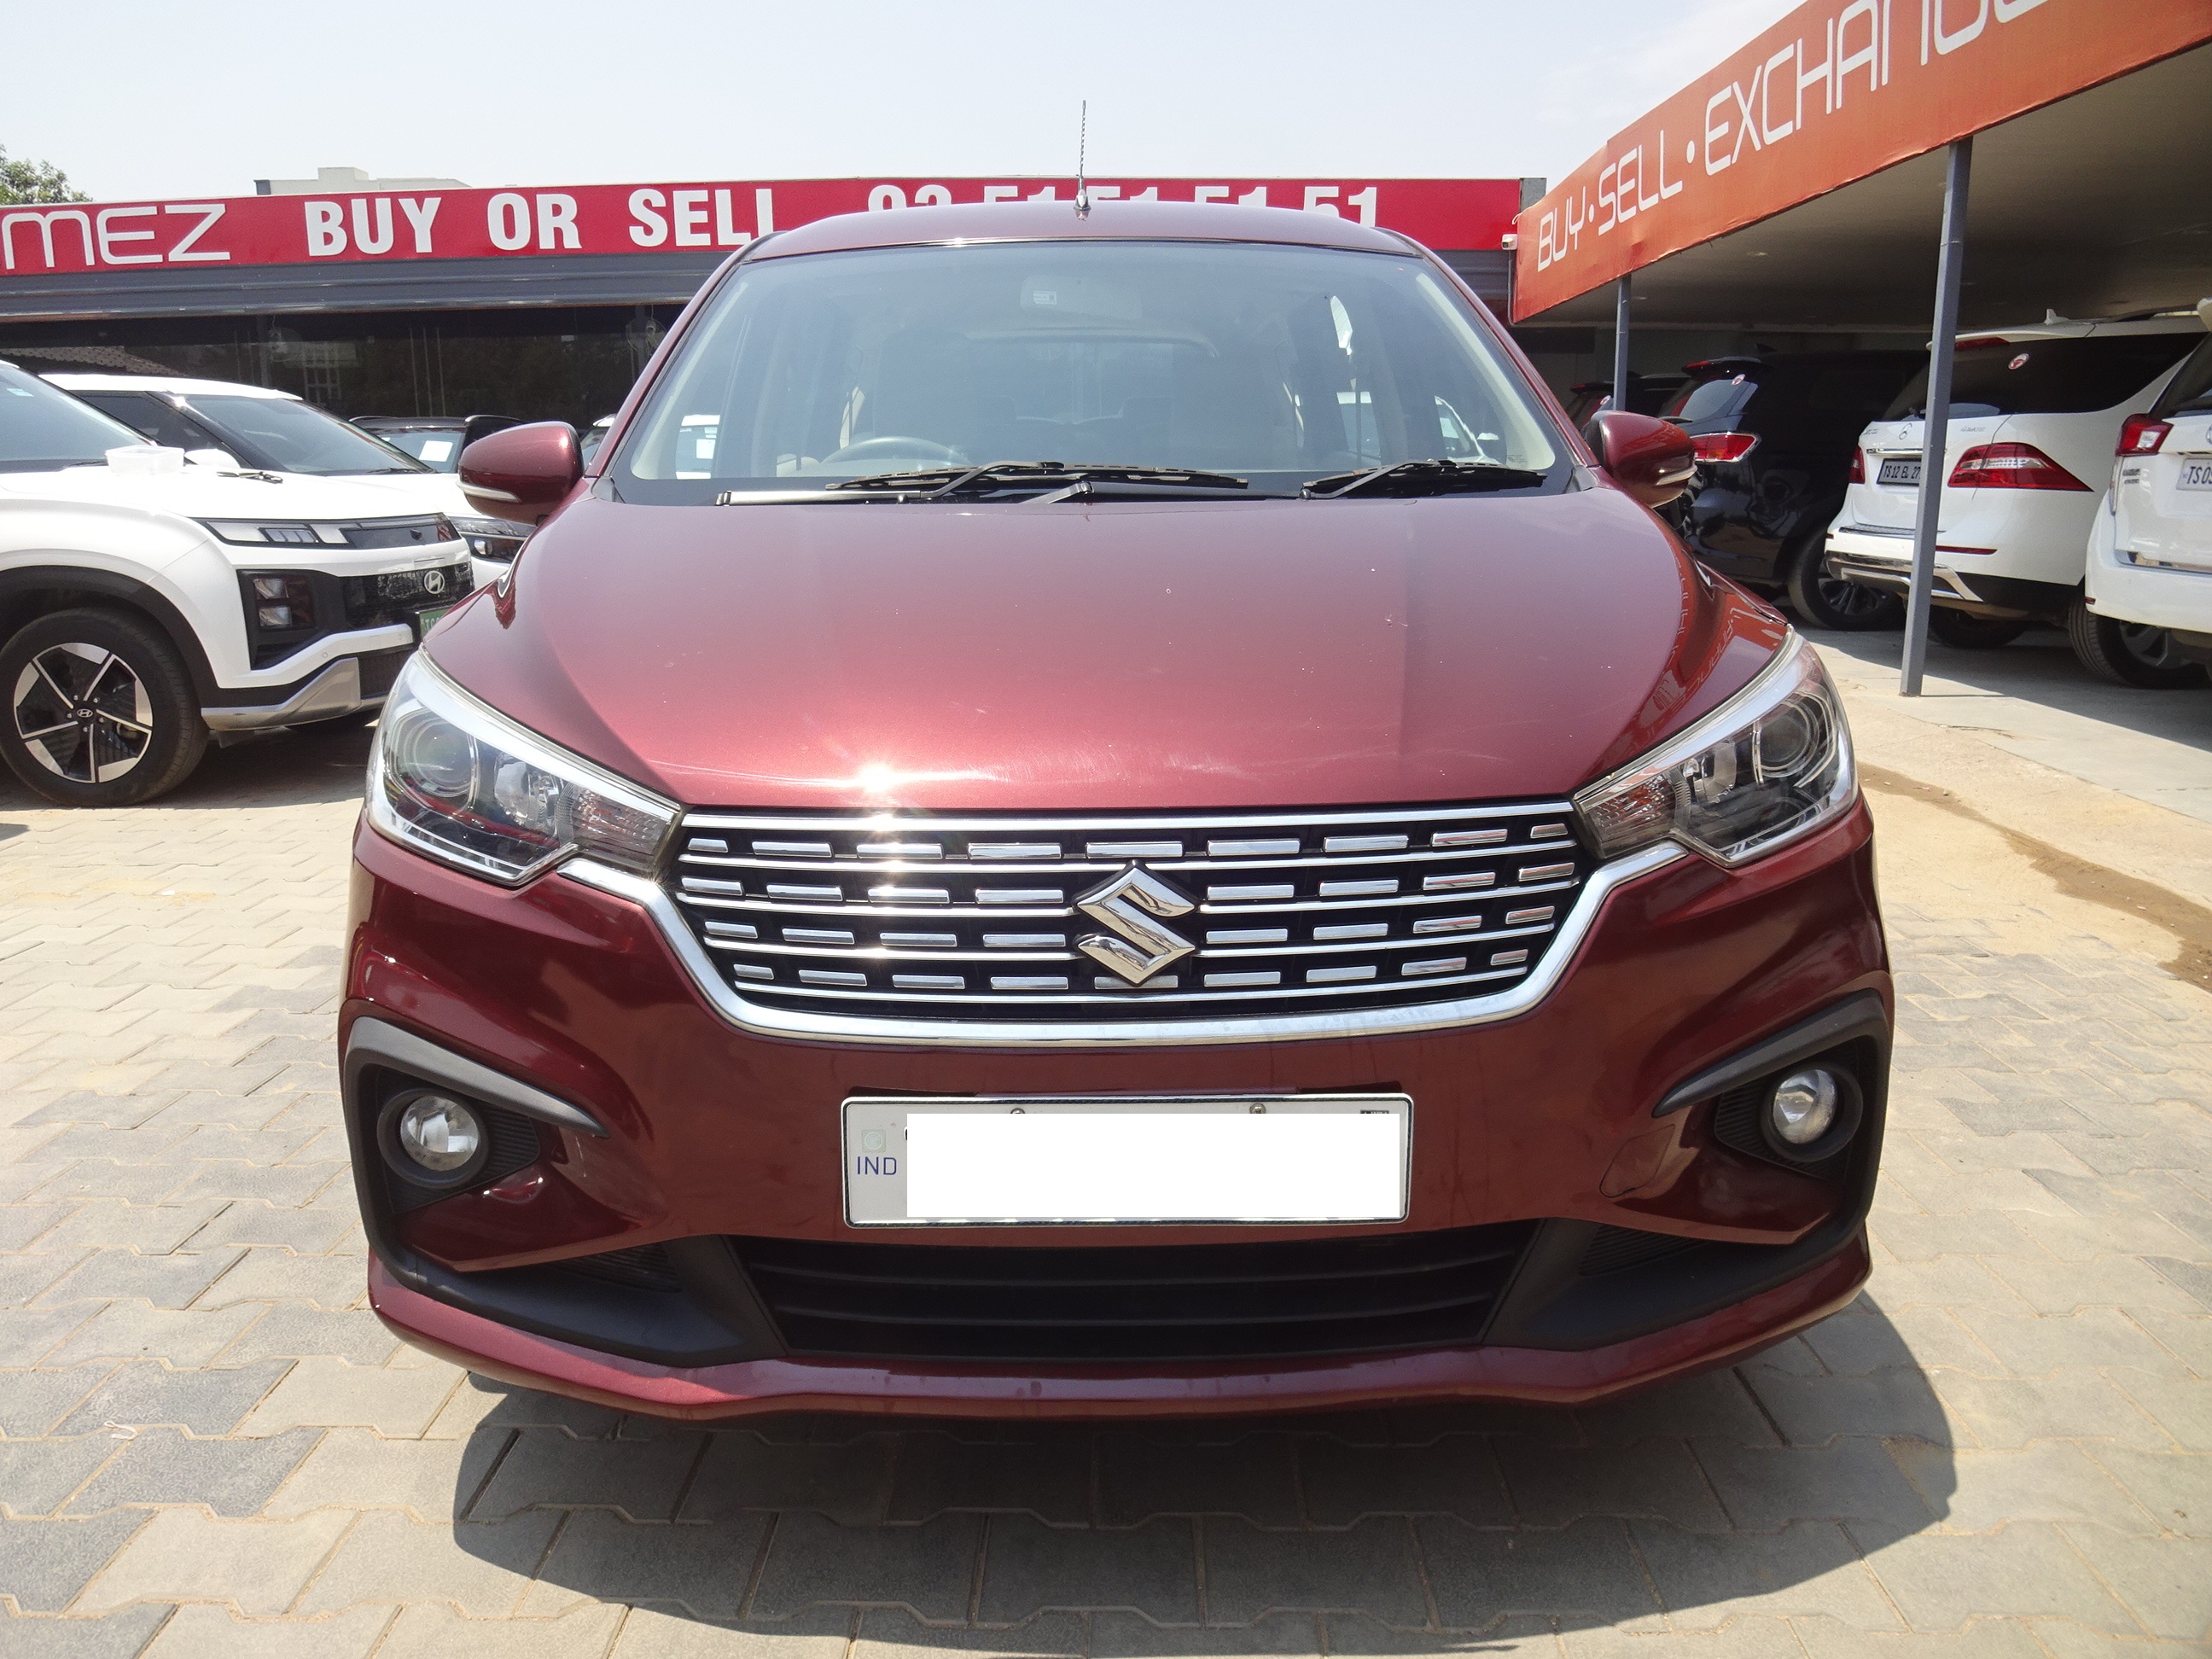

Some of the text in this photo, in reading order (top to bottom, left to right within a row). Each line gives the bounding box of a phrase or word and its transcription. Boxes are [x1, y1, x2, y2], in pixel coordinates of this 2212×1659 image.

[304, 196, 442, 258] BUY
[487, 193, 583, 251] OR
[628, 188, 774, 247] SELL
[1538, 185, 1586, 272] BUY
[1598, 130, 1683, 236] SELL
[857, 1155, 897, 1175] IND
